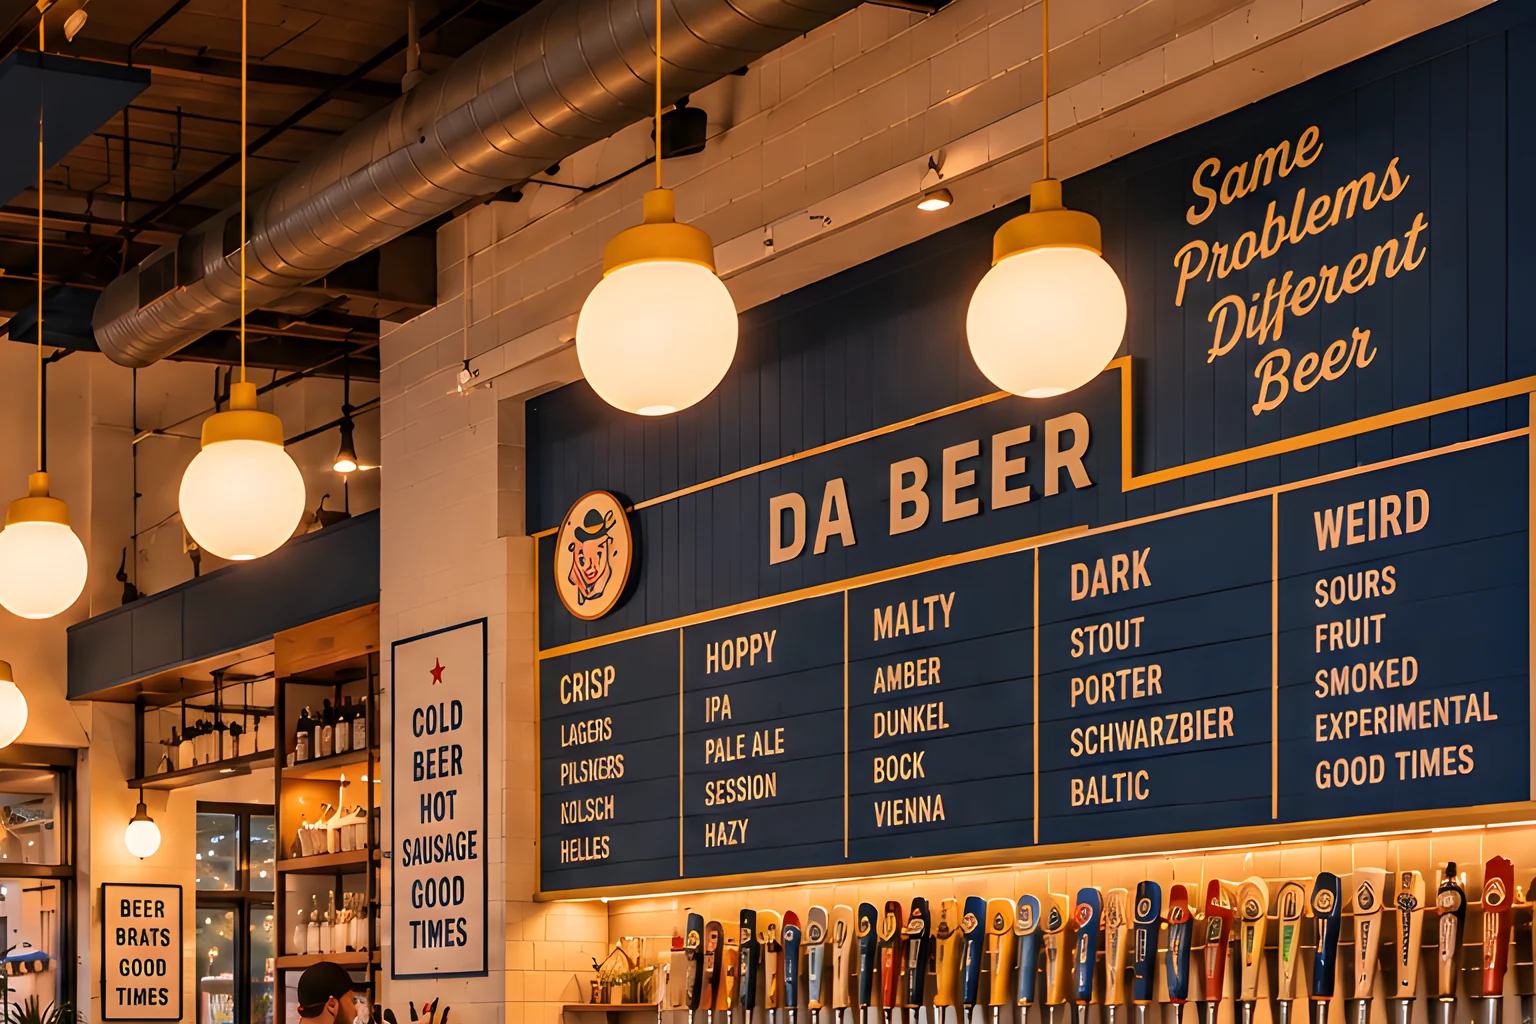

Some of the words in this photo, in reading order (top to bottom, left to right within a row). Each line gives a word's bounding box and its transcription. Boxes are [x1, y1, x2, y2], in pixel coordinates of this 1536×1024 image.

[1186, 125, 1323, 226] Same
[1173, 156, 1410, 307] Problems
[1207, 212, 1429, 364] Different
[1252, 326, 1377, 416] Beer
[769, 477, 856, 566] DA
[889, 411, 1095, 536] BEER
[1313, 488, 1430, 552] WEIRD
[1070, 547, 1152, 601] DARK
[1314, 565, 1397, 608] SOURS
[873, 592, 956, 641] MALTY
[1315, 613, 1387, 653] FRUIT
[705, 629, 777, 675] HOPPY
[1070, 616, 1146, 658] STOUT
[560, 665, 616, 705] CRISP
[873, 656, 942, 694] AMBER
[1070, 664, 1163, 708] PORTER
[1314, 656, 1418, 698] SMOKED
[412, 699, 464, 739] COLD
[705, 693, 732, 724] IPA
[873, 701, 950, 739] DUNKEL
[1315, 691, 1499, 742] EXPERIMENTAL
[705, 733, 746, 765] PALE
[752, 727, 785, 757] ALE
[1070, 706, 1235, 757] SCHWARZBIER
[413, 744, 464, 783] BEER
[873, 750, 926, 784] BOCK
[1315, 754, 1386, 791] GOOD
[1395, 744, 1474, 782] TIMES
[420, 789, 457, 825] HOT
[705, 771, 777, 806] SESSION
[1070, 769, 1150, 807] BALTIC
[874, 793, 946, 828] VIENNA
[402, 829, 478, 867] SAUSAGE
[560, 835, 611, 864] HELLES
[705, 817, 749, 848] HAZY
[120, 899, 165, 918] BEER
[411, 875, 464, 909] GOOD
[116, 927, 171, 947] BRATS
[409, 917, 468, 949] TIMES
[119, 958, 167, 977] GOOD
[115, 987, 169, 1006] TIMES
